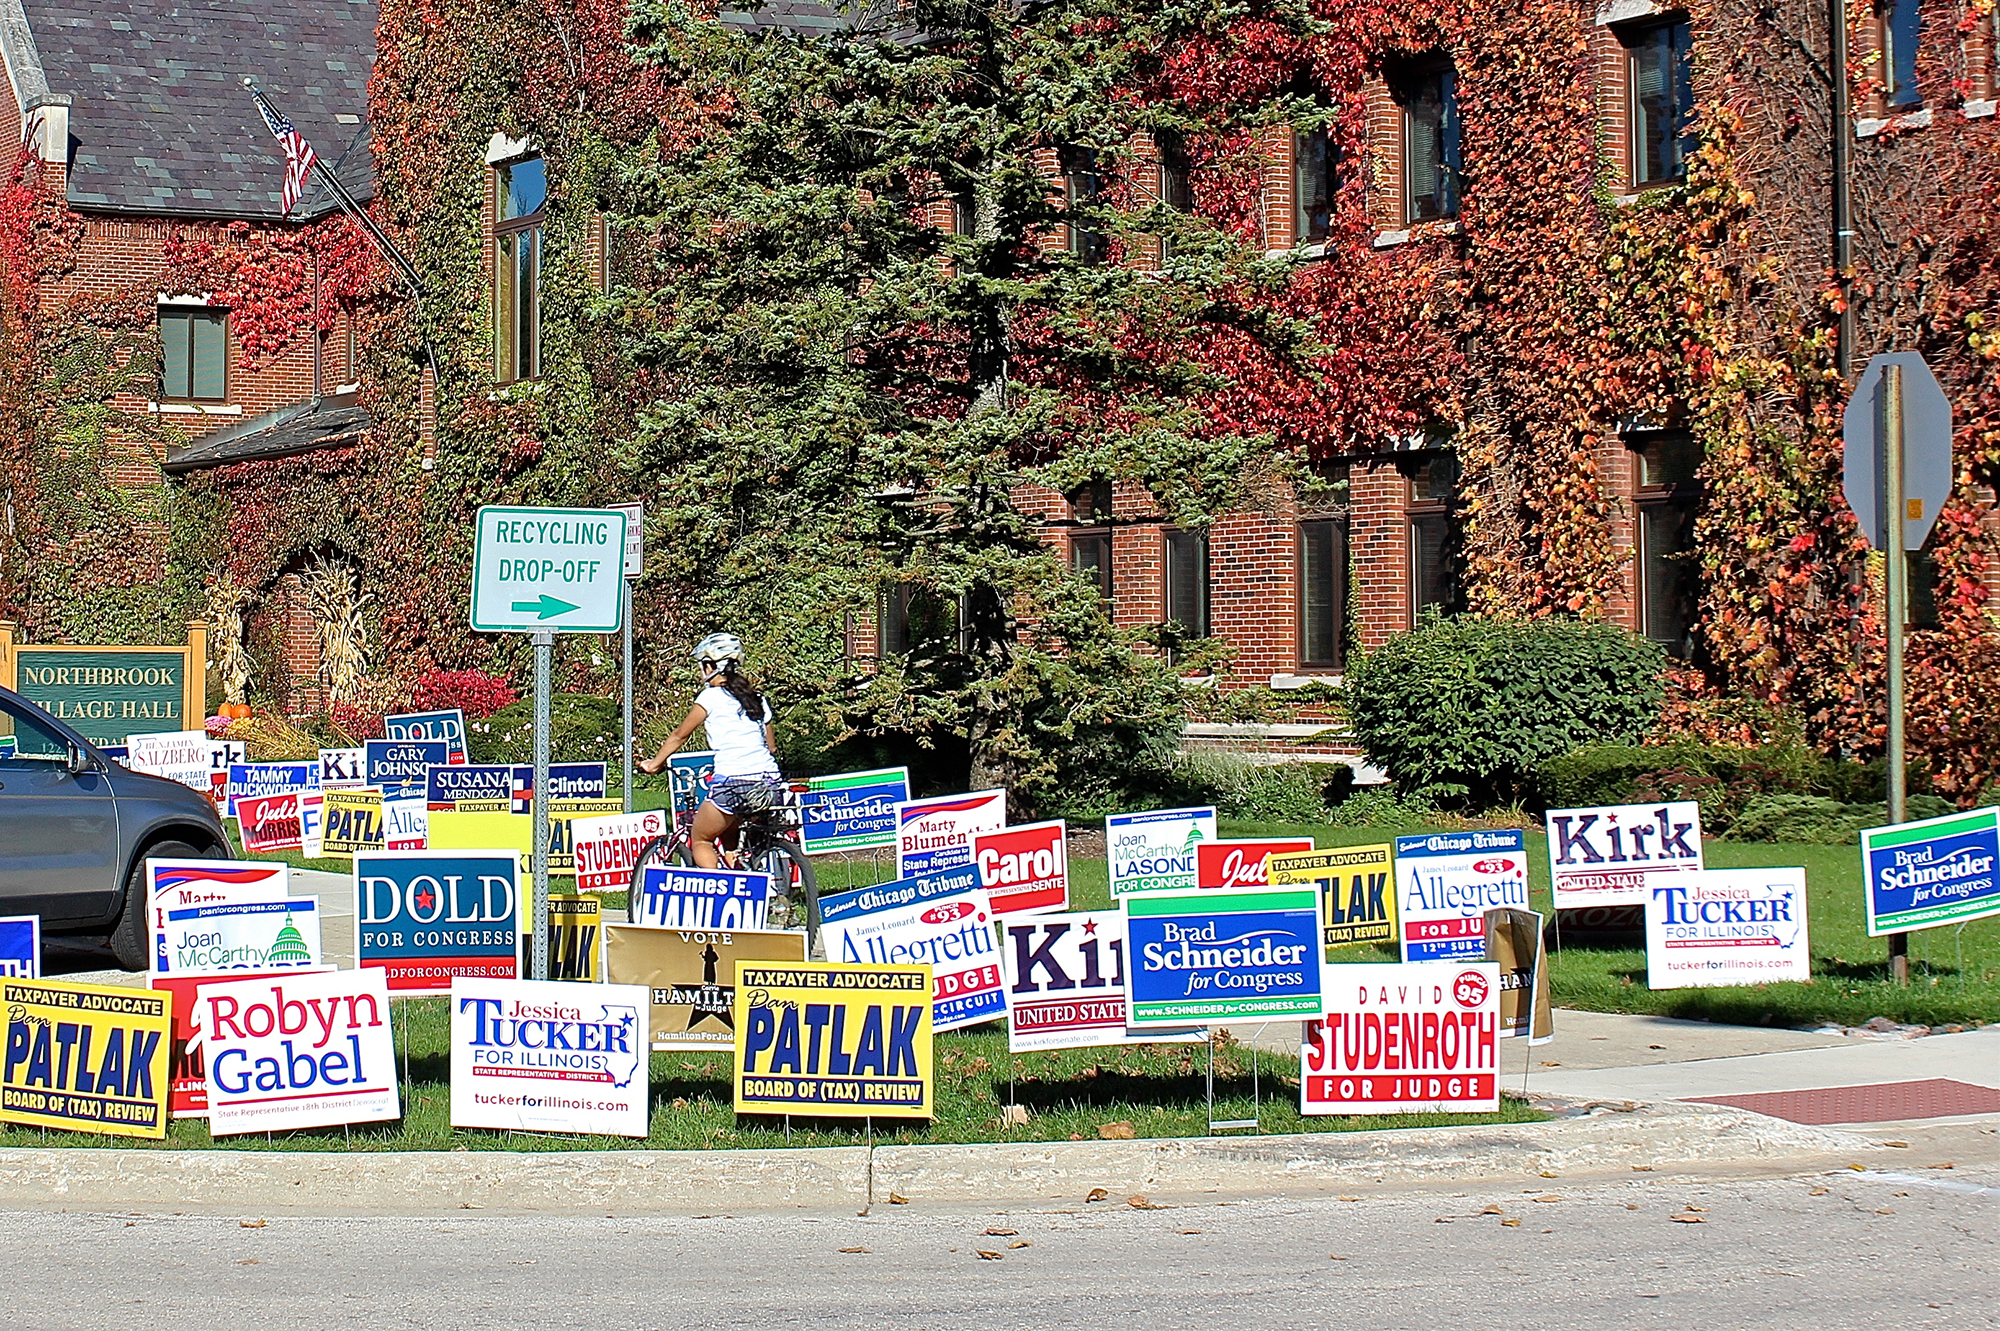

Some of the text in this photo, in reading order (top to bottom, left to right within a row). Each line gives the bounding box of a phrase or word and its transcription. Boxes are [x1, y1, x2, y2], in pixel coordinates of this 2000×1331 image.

[496, 520, 608, 545] RECYCLING
[499, 559, 601, 582] DROP-OFF
[25, 667, 175, 685] NORTHBROOK
[122, 701, 179, 719] HALL
[388, 720, 460, 740] DOLD
[145, 739, 194, 749] BENJAMIN
[137, 747, 205, 767] SALZBERG
[211, 744, 241, 768] rk
[386, 749, 426, 761] GARY
[185, 770, 207, 779] STATE
[245, 770, 292, 784] TAMMY
[436, 772, 510, 788] SUSANA
[443, 789, 505, 799] MENDOZA
[548, 777, 603, 793] Clinton
[460, 803, 500, 812] TAXPAYER
[580, 803, 622, 811] ADVOCATE
[819, 792, 850, 807] Brad
[255, 800, 297, 832] Juli
[599, 823, 638, 836] DAVID
[833, 817, 896, 835] for Congres
[920, 820, 957, 834] Marty
[1114, 833, 1147, 848] Joan
[1427, 836, 1472, 850] Chicago
[1473, 833, 1518, 848] Tribune
[1552, 807, 1698, 865] Kirk
[1115, 844, 1183, 861] McCarthy
[1273, 852, 1385, 871] TAXPAYER ADVOCATE
[1894, 846, 1933, 866] Brad
[904, 860, 928, 871] State
[978, 839, 1063, 887] Carol
[1221, 849, 1269, 888] Jul
[1443, 864, 1469, 872] Leonard
[1880, 854, 1994, 890] Schneider
[586, 875, 611, 887] FOR
[659, 872, 729, 895] James
[734, 876, 752, 897] E.
[1032, 877, 1064, 891] SENTE
[1116, 873, 1195, 893] FOR CONGRE
[1557, 873, 1645, 889] UNITED STATE
[360, 875, 514, 924] DOLD
[858, 887, 916, 910] Chicago
[916, 873, 974, 897] Tribune
[1405, 865, 1525, 917] Allegretti
[1692, 885, 1750, 900] Jessica
[1910, 877, 1993, 907] for Congress
[198, 903, 286, 917] joanforcongress.com
[557, 902, 597, 913] ADVOCATE
[855, 916, 916, 937] James Leonard
[1162, 921, 1217, 943] Brad
[1327, 924, 1389, 943] (TAX) REVIEW
[1420, 924, 1449, 936] FOR
[1666, 925, 1769, 938] FOR ILLINOIS
[177, 931, 222, 949] Joan
[363, 930, 514, 948] FOR CONGRESS
[678, 931, 734, 945] VOTE
[843, 912, 995, 965] Allegretti
[178, 945, 271, 968] McCarthy
[1143, 938, 1307, 971] Schneider
[1668, 959, 1793, 970] tuckerforillinois.com
[745, 972, 922, 989] TAXPAYER ADVOCATE
[1183, 970, 1304, 996] for Congress
[1459, 973, 1488, 989] PUNCH
[6, 987, 162, 1015] TAXPAYER ADVOCATE
[653, 989, 735, 1006] HAMILT
[747, 988, 799, 1010] Dan
[1359, 986, 1442, 1005] DAVID
[1456, 984, 1484, 1005] 95
[8, 1004, 52, 1027] Dan
[207, 986, 382, 1048] Robyn
[509, 1000, 581, 1020] Jessica
[701, 1004, 728, 1013] Judge
[1015, 1002, 1125, 1027] UNITED STATE
[743, 1003, 924, 1077] PATLAK
[1014, 1035, 1099, 1049] www.kirkforsenate.com
[1307, 1011, 1495, 1072] STUDENROTH
[3, 1021, 162, 1099] PATLAK
[213, 1035, 367, 1094] Gabel
[474, 1050, 601, 1069] FOR ILLINOIS
[475, 1067, 497, 1075] STATE
[498, 1069, 560, 1079] REPRESENTATIVE
[566, 1073, 599, 1081] DISTRICT
[744, 1080, 921, 1103] BOARD OF (TAX) REVIEW
[1323, 1078, 1479, 1099] FOR JUDGE
[4, 1090, 155, 1122] BOARD OF (TAX) REVIEW
[218, 1097, 389, 1118] State Representative 18th District Democrat
[475, 1093, 629, 1112] tuckerforillinois.com
